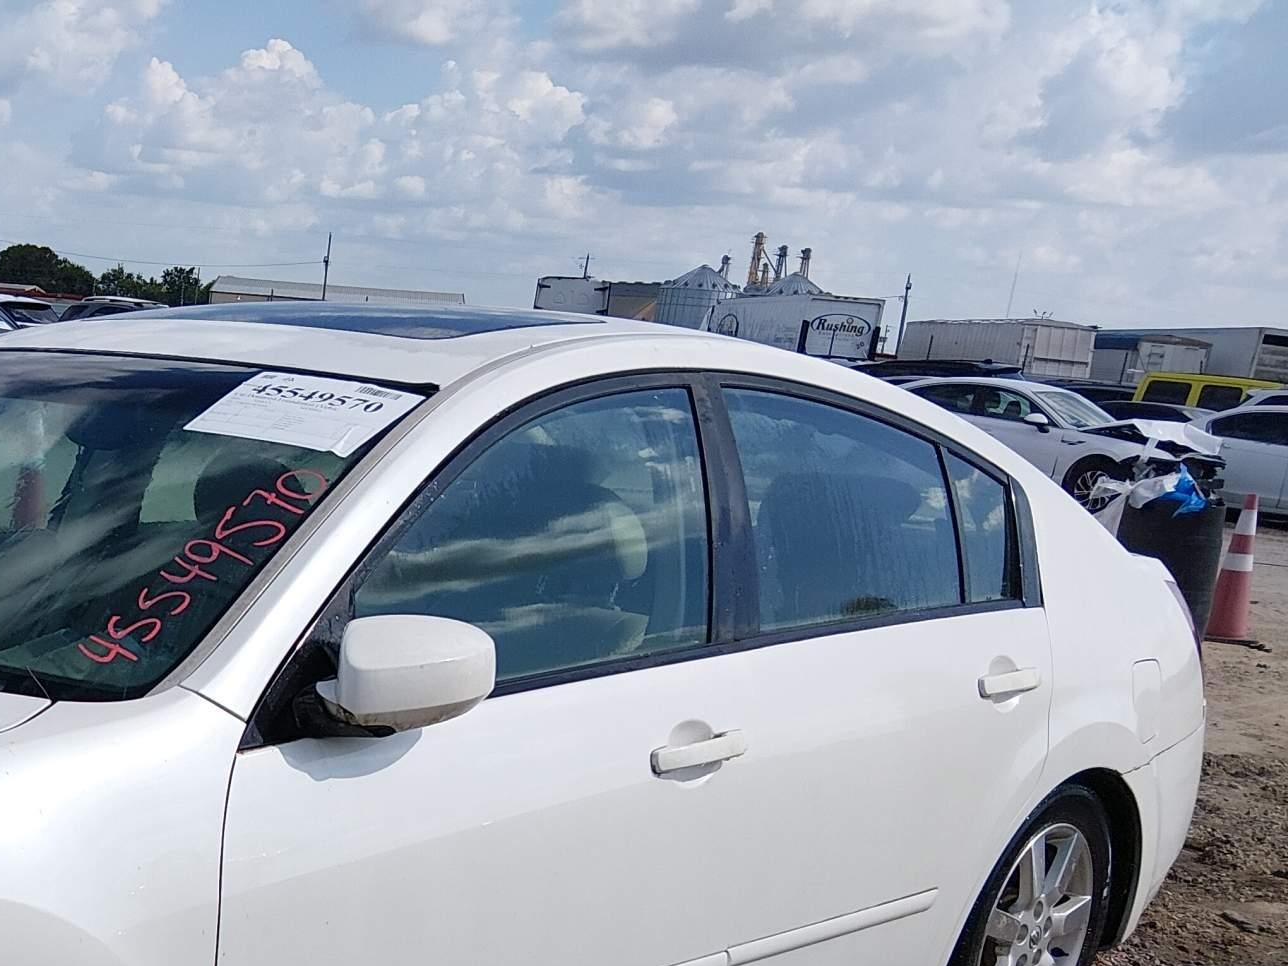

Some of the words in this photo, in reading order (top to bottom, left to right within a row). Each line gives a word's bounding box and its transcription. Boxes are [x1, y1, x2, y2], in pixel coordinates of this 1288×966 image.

[816, 318, 865, 337] Rushing
[252, 383, 384, 413] 45549570
[78, 469, 330, 663] 45549570
